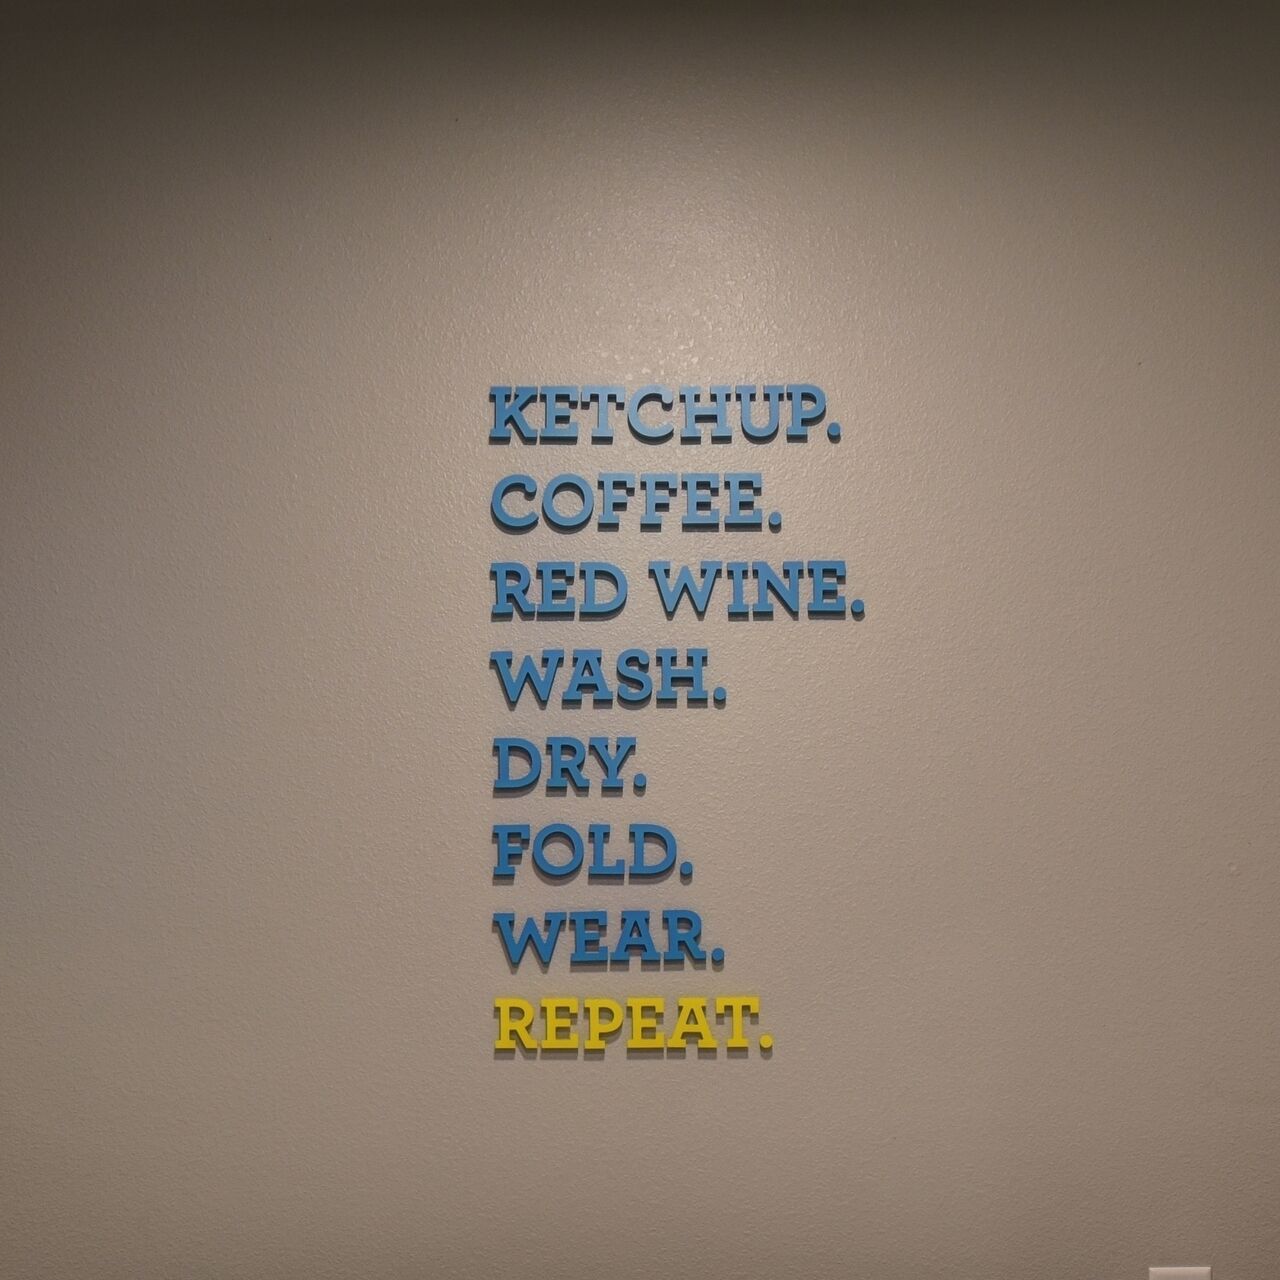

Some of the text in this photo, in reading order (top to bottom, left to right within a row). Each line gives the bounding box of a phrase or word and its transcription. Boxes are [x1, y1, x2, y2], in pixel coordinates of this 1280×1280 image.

[489, 384, 841, 443] KETCHUP.
[491, 473, 782, 531] COFFEE.
[491, 560, 865, 618] RED WINE.
[489, 648, 727, 705] WASH.
[493, 737, 646, 792] DRY.
[493, 823, 693, 880] FOLD.
[493, 910, 725, 968] WEAR.
[494, 997, 773, 1053] REPEAT.
